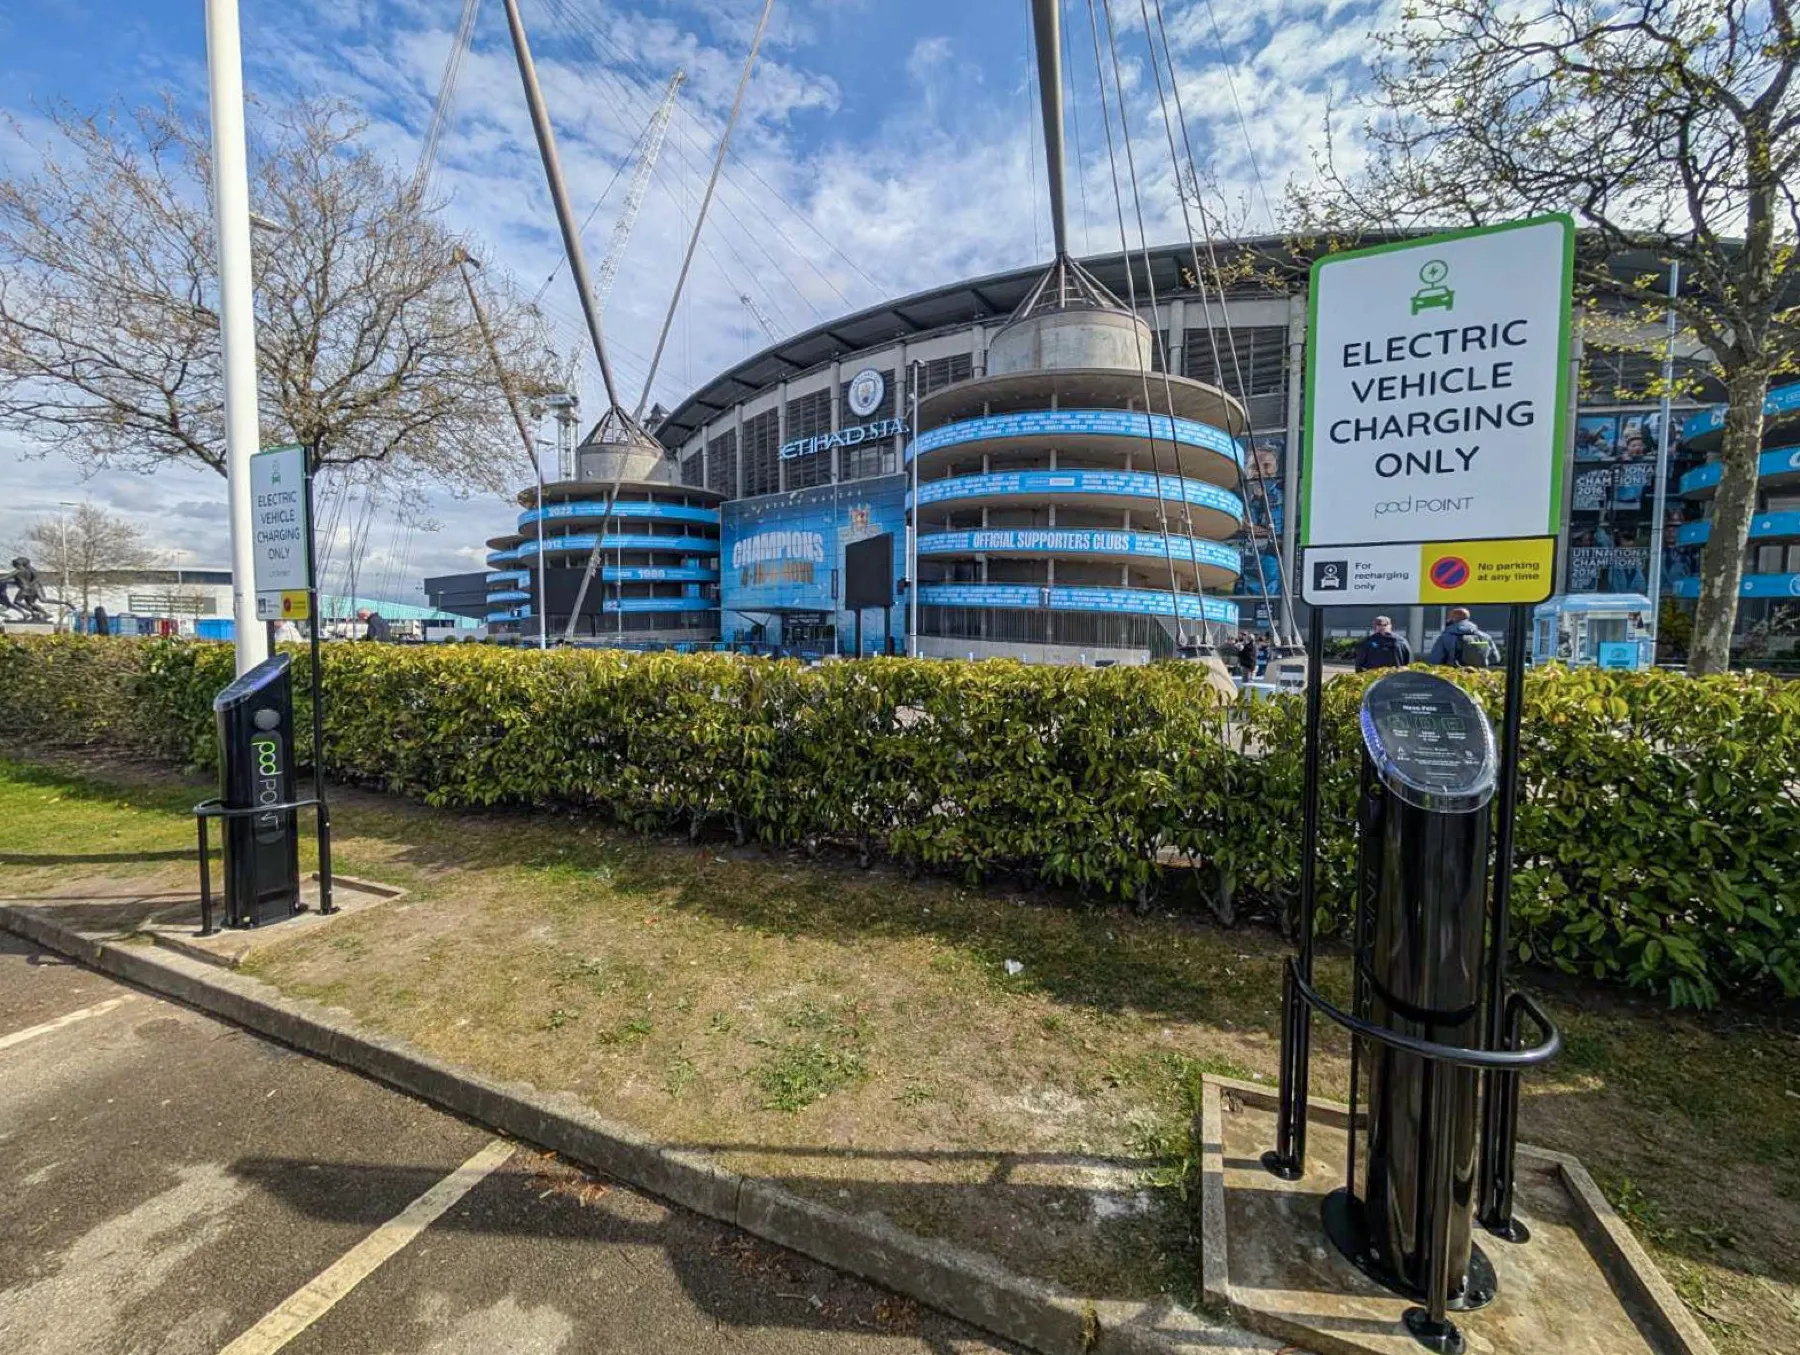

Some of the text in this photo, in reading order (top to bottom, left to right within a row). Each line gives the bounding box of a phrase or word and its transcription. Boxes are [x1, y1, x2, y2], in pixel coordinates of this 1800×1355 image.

[1342, 319, 1528, 368] ELECTRIC
[1351, 361, 1513, 403] VEHICLE
[1329, 400, 1534, 444] CHARGING
[780, 427, 865, 459] ETIHAD
[1375, 445, 1480, 478] ONLY
[257, 490, 297, 507] ELECTRIC
[1374, 494, 1474, 518] pod POINT
[260, 509, 296, 525] VEHICLE
[257, 528, 300, 544] CHARGING
[973, 531, 1016, 548] OFFICIAL
[1017, 531, 1090, 550] SUPPORTERS
[1093, 533, 1129, 550] CLUBS
[267, 547, 290, 560] ONLY
[733, 531, 824, 569] CHAMPIONS
[1355, 562, 1372, 570] For
[1478, 561, 1540, 573] No parking
[1354, 571, 1409, 582] recharging
[1477, 572, 1540, 583] at any time
[1353, 582, 1376, 591] only
[252, 741, 283, 776] pod
